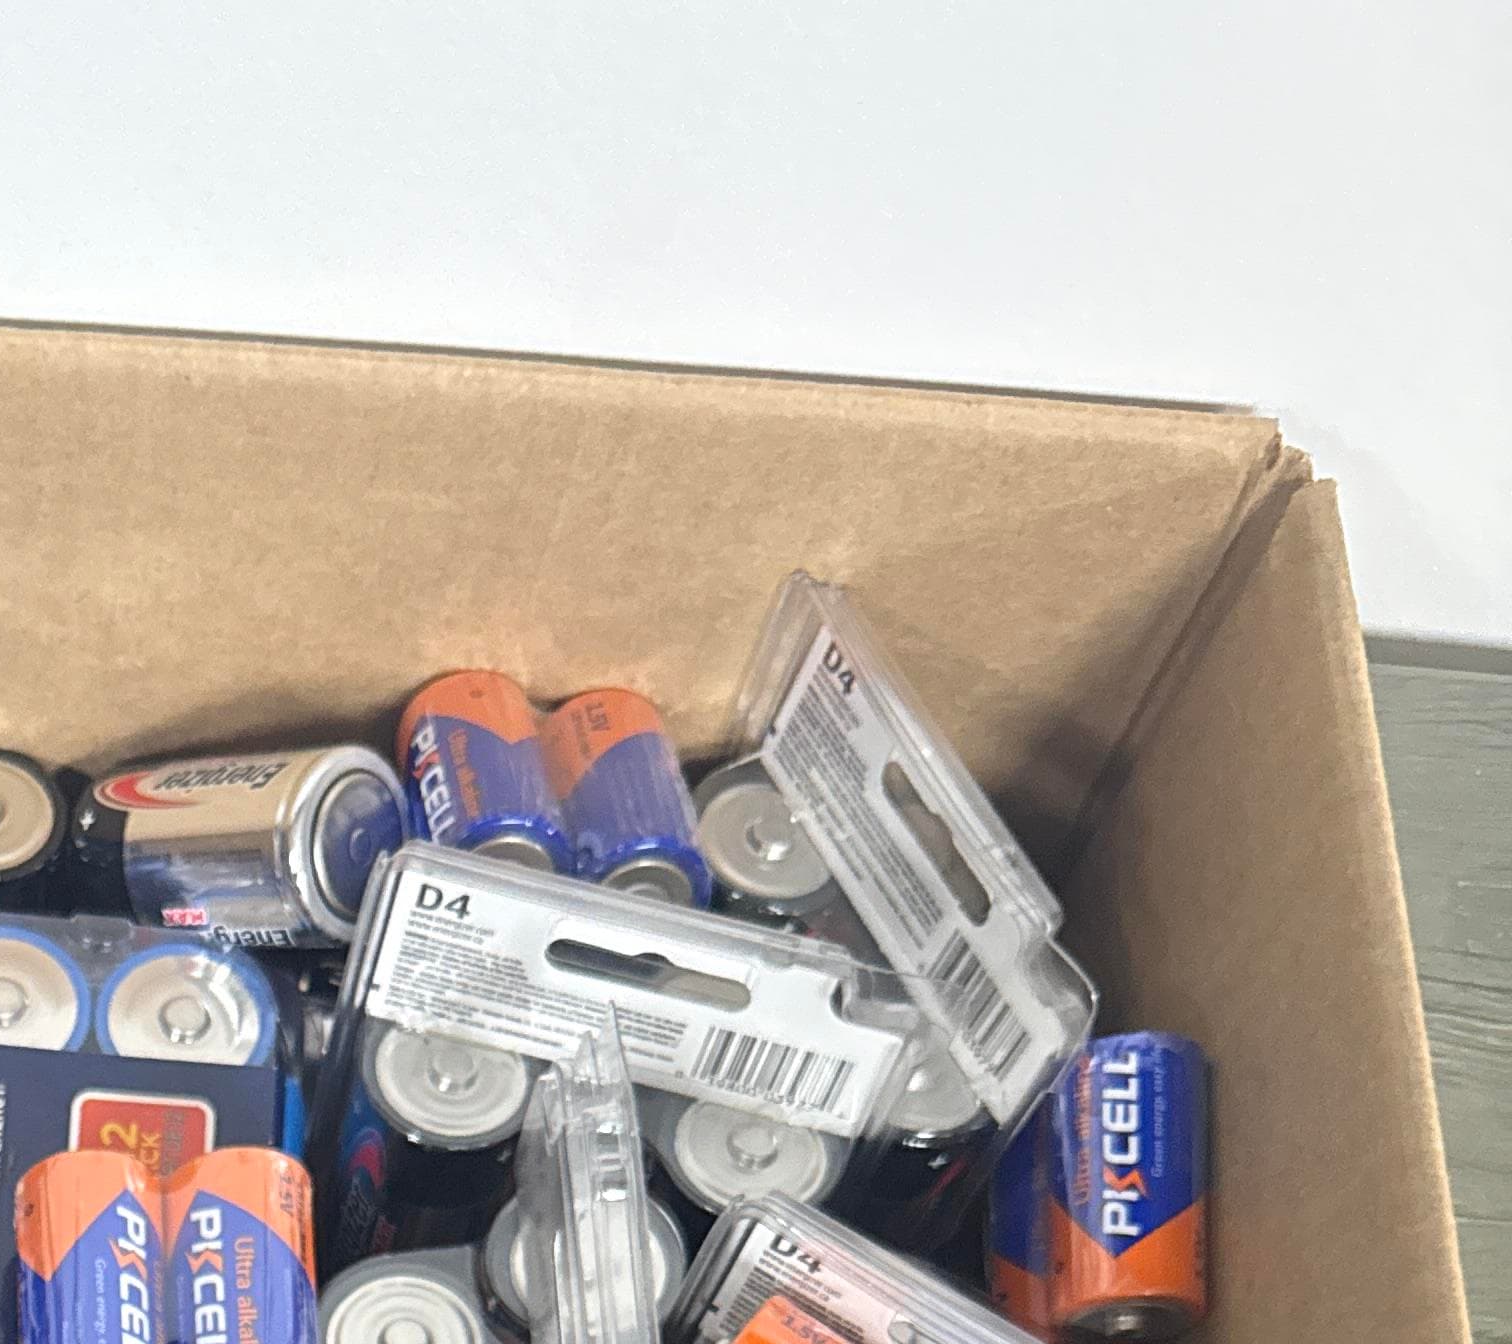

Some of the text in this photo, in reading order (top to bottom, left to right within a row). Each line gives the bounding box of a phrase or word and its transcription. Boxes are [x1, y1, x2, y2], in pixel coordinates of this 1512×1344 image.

[821, 642, 856, 695] D4
[154, 763, 287, 790] Energizer
[414, 884, 471, 919] D4
[1100, 1050, 1149, 1237] PKCELL
[233, 1237, 255, 1290] Ultra
